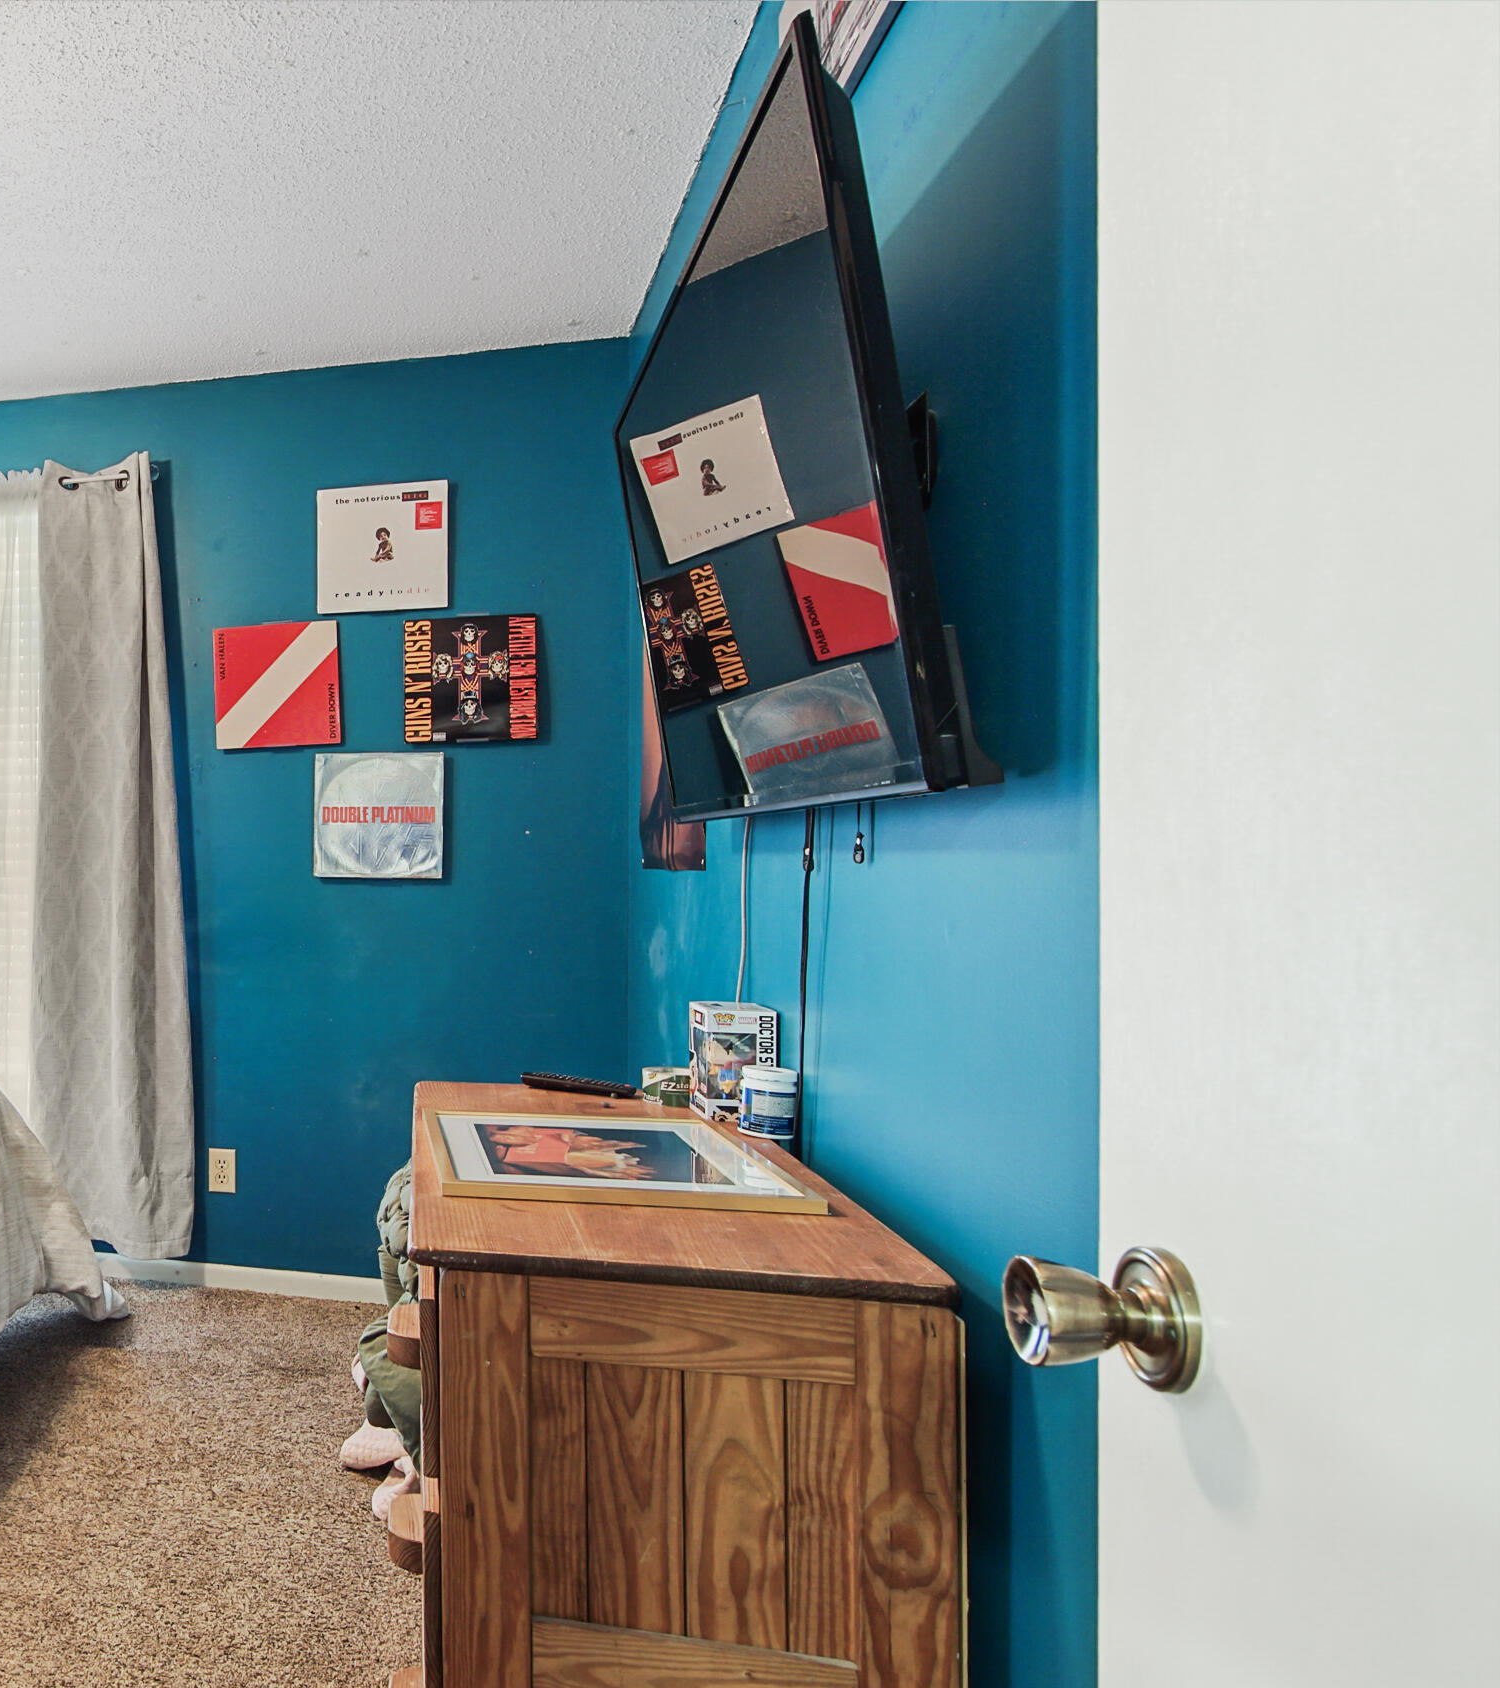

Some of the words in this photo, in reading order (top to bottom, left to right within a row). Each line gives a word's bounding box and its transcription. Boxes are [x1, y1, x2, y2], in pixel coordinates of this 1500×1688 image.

[354, 495, 401, 503] notorious
[404, 620, 432, 675] ROSES
[508, 616, 536, 658] APPETITE
[328, 683, 336, 712] DOWN
[329, 714, 337, 739] DIVER
[404, 697, 432, 743] GUNS
[322, 806, 369, 823] DOUBLE
[371, 806, 436, 824] PLATINUM
[759, 1015, 774, 1056] DOCTOR
